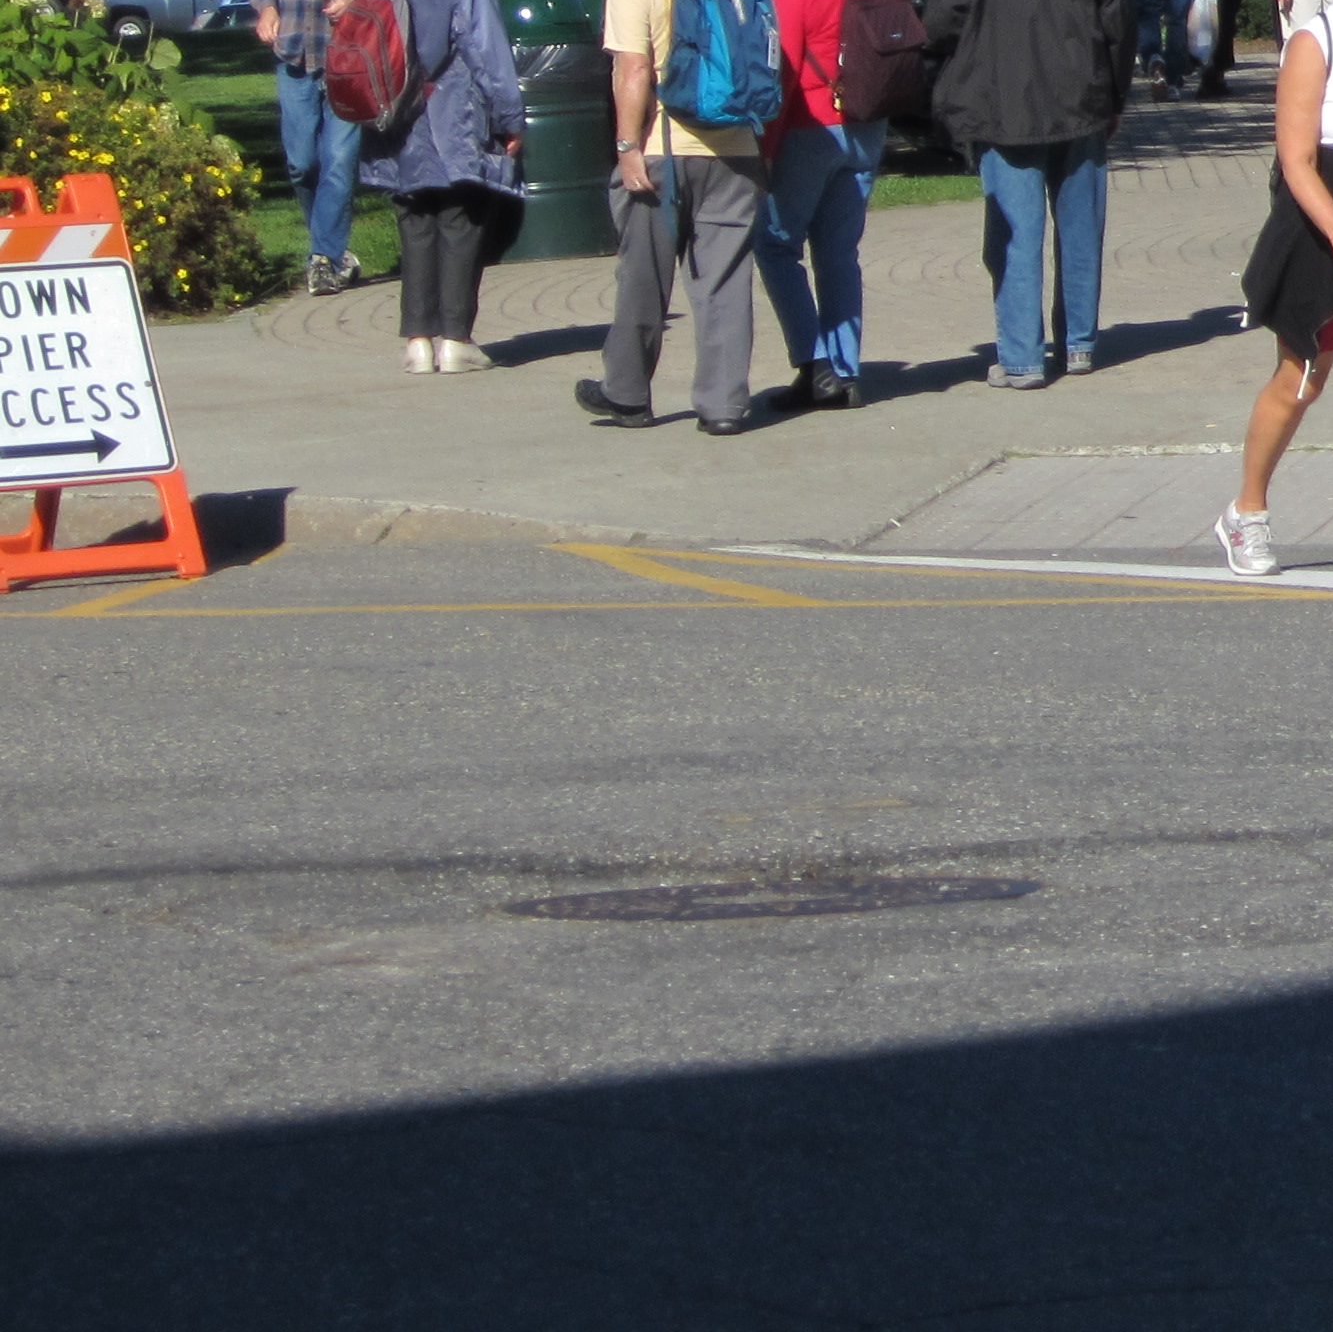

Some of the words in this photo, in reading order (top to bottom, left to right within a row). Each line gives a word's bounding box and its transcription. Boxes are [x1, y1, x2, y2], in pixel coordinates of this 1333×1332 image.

[0, 277, 91, 319] OWN
[0, 332, 92, 373] PIER
[1, 382, 141, 428] CCESS
